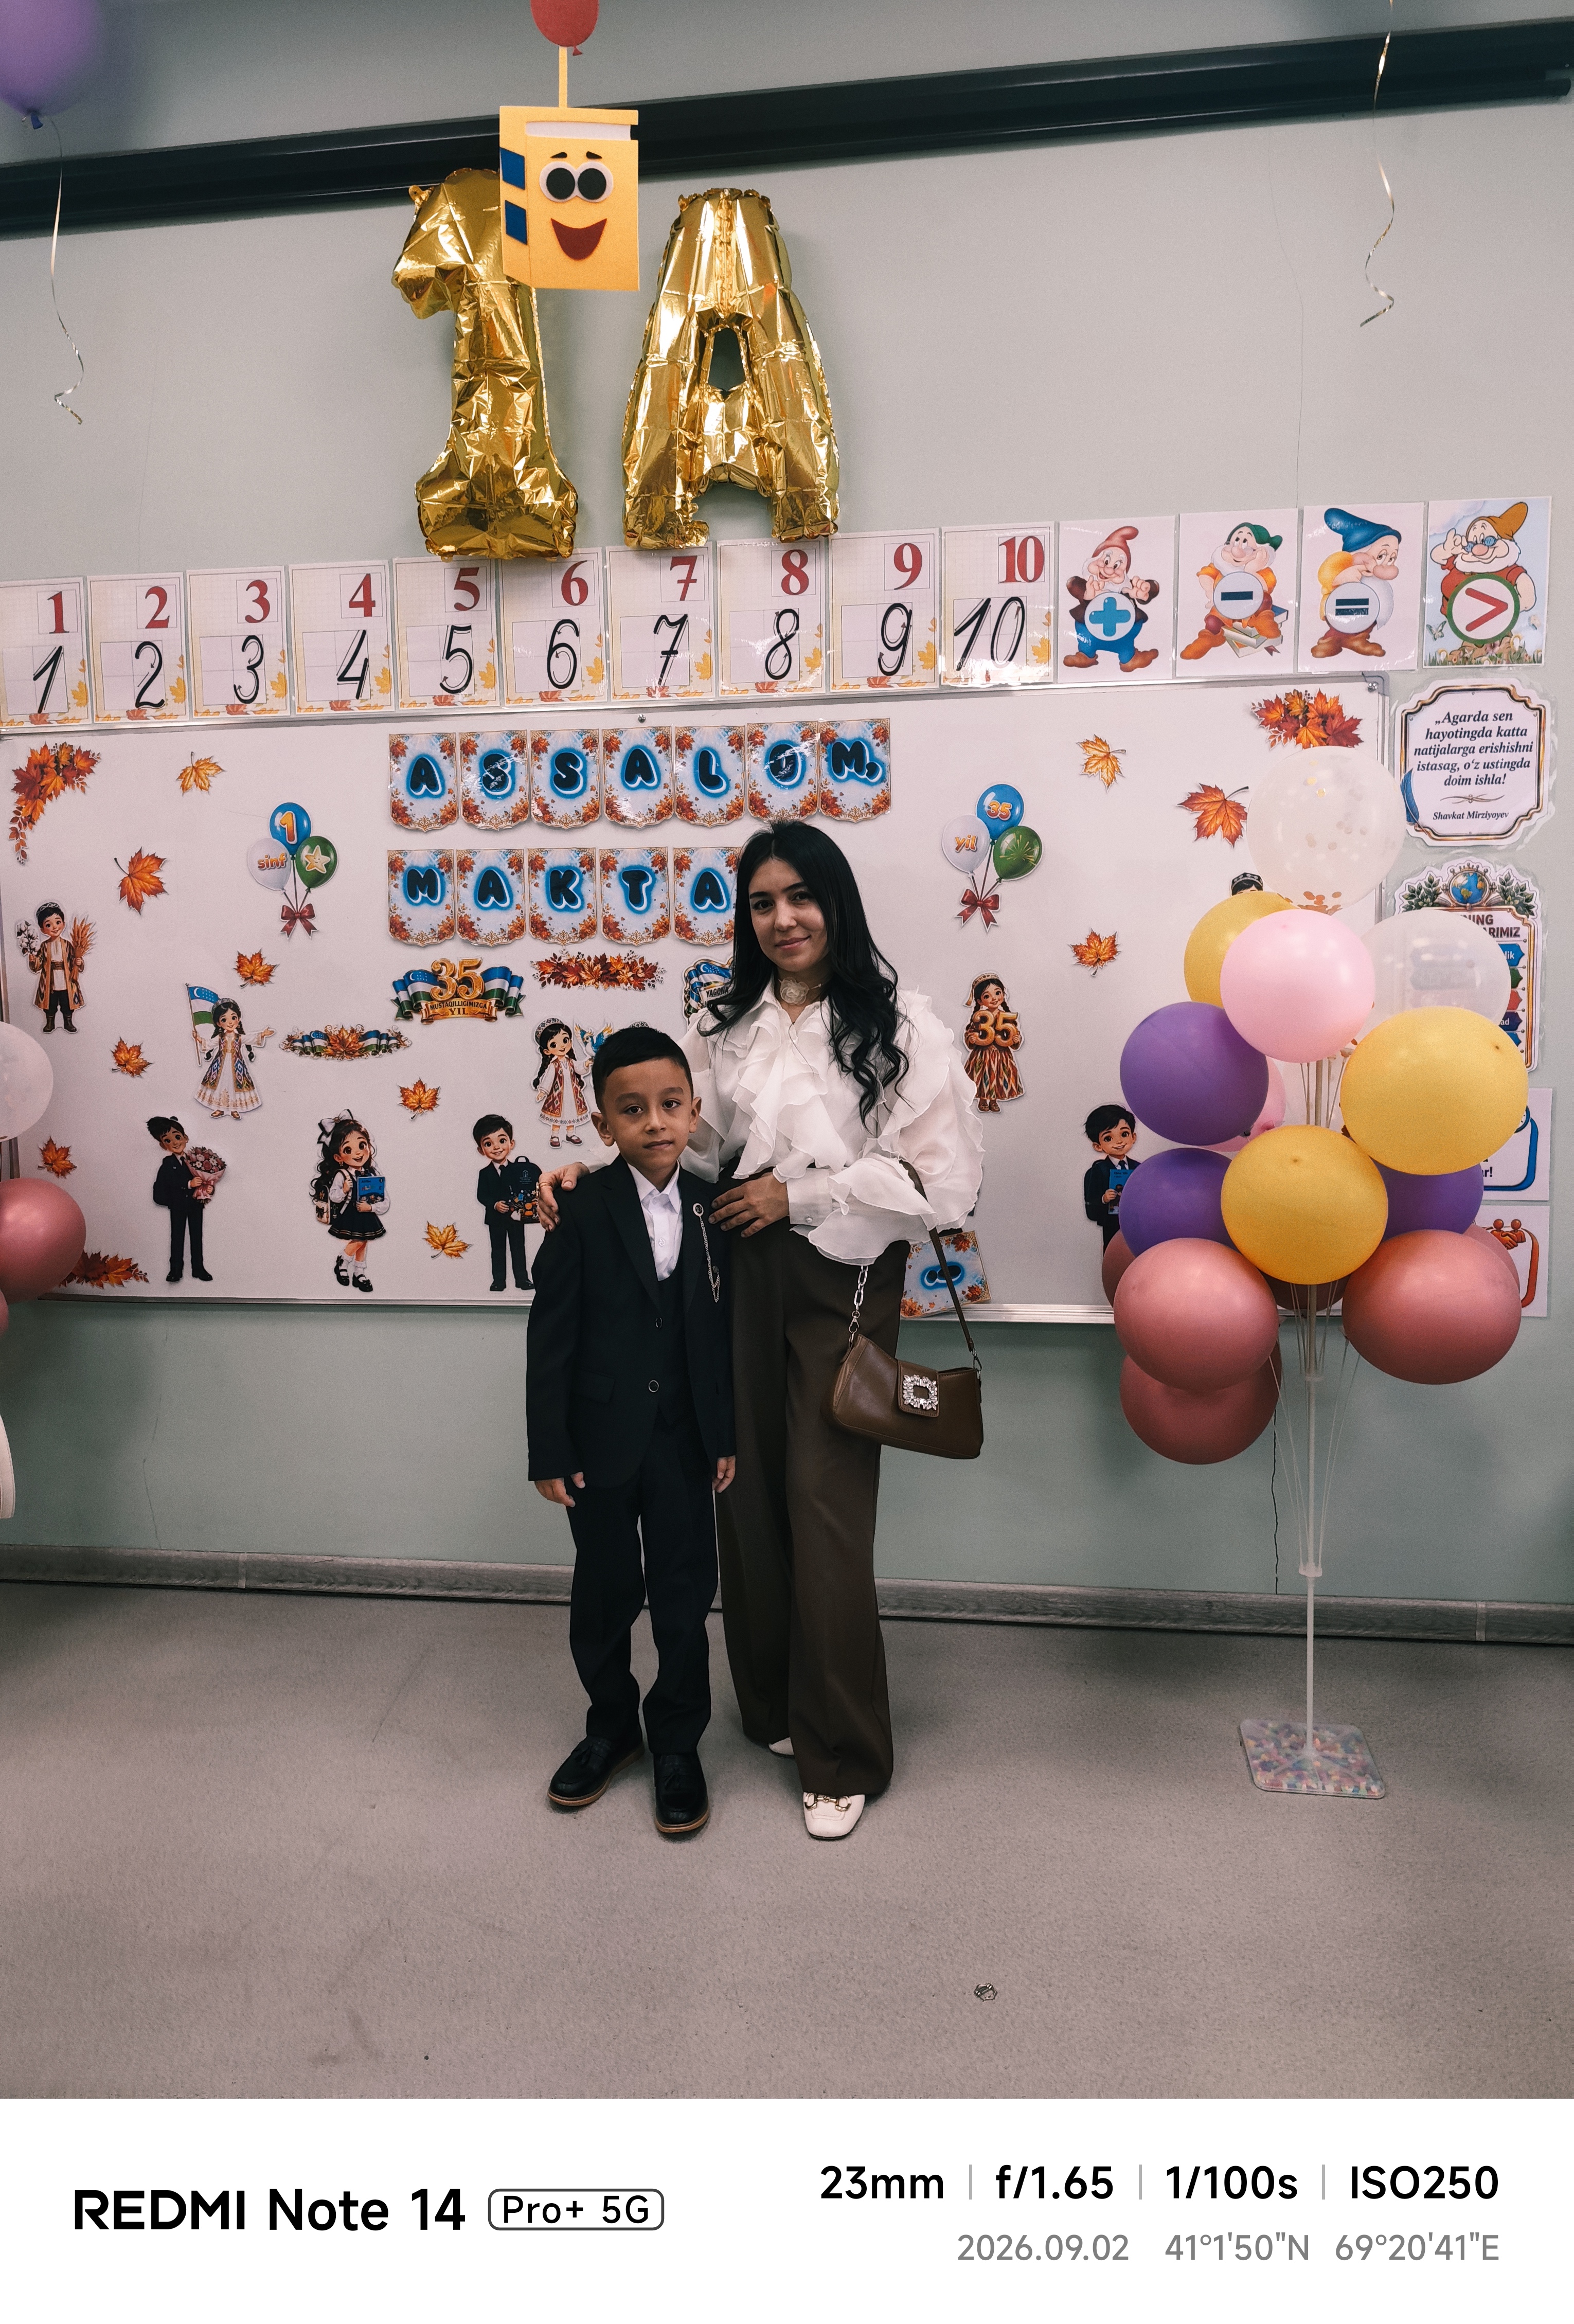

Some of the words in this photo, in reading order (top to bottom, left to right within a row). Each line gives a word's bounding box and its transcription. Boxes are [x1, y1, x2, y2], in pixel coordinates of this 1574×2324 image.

[392, 168, 579, 561] 1
[622, 188, 840, 549] A
[670, 556, 697, 601] 7
[781, 549, 809, 595] 8
[893, 543, 923, 589] 9
[999, 535, 1045, 583] 10
[244, 580, 271, 623] 3
[349, 573, 376, 617] 4
[454, 567, 480, 611] 5
[561, 561, 588, 606] 6
[47, 591, 69, 634] 1
[145, 586, 170, 629] 2
[547, 619, 580, 689] 6
[653, 614, 688, 686] 7
[765, 608, 799, 680] 8
[878, 602, 913, 676] 9
[954, 597, 1026, 671] 10
[33, 646, 64, 713] 1
[134, 641, 165, 709] 2
[234, 635, 264, 704] 3
[336, 629, 369, 700] 4
[440, 624, 473, 694] 5
[1425, 726, 1492, 742] hayotingda
[1496, 726, 1528, 737] katta
[1493, 712, 1513, 721] sen
[1414, 743, 1475, 758] natijalarga
[1478, 741, 1534, 754] erishishni
[1417, 761, 1460, 773] istasag,
[1483, 757, 1530, 772] ustingda
[1444, 775, 1471, 786] doim
[1475, 773, 1507, 785] ishla!
[279, 811, 297, 844] 1
[987, 800, 1012, 820] 35
[1433, 811, 1464, 820] Shavkat
[1466, 810, 1509, 820] Mirziyoyev
[258, 853, 287, 870] sinf
[955, 834, 977, 853] yil
[406, 868, 727, 911] MAKTA
[1482, 926, 1521, 938] RIMIZ
[430, 957, 484, 1001] 35
[430, 1000, 487, 1011] MUSTAQILLIGIMIZGA
[972, 1010, 1018, 1047] 35
